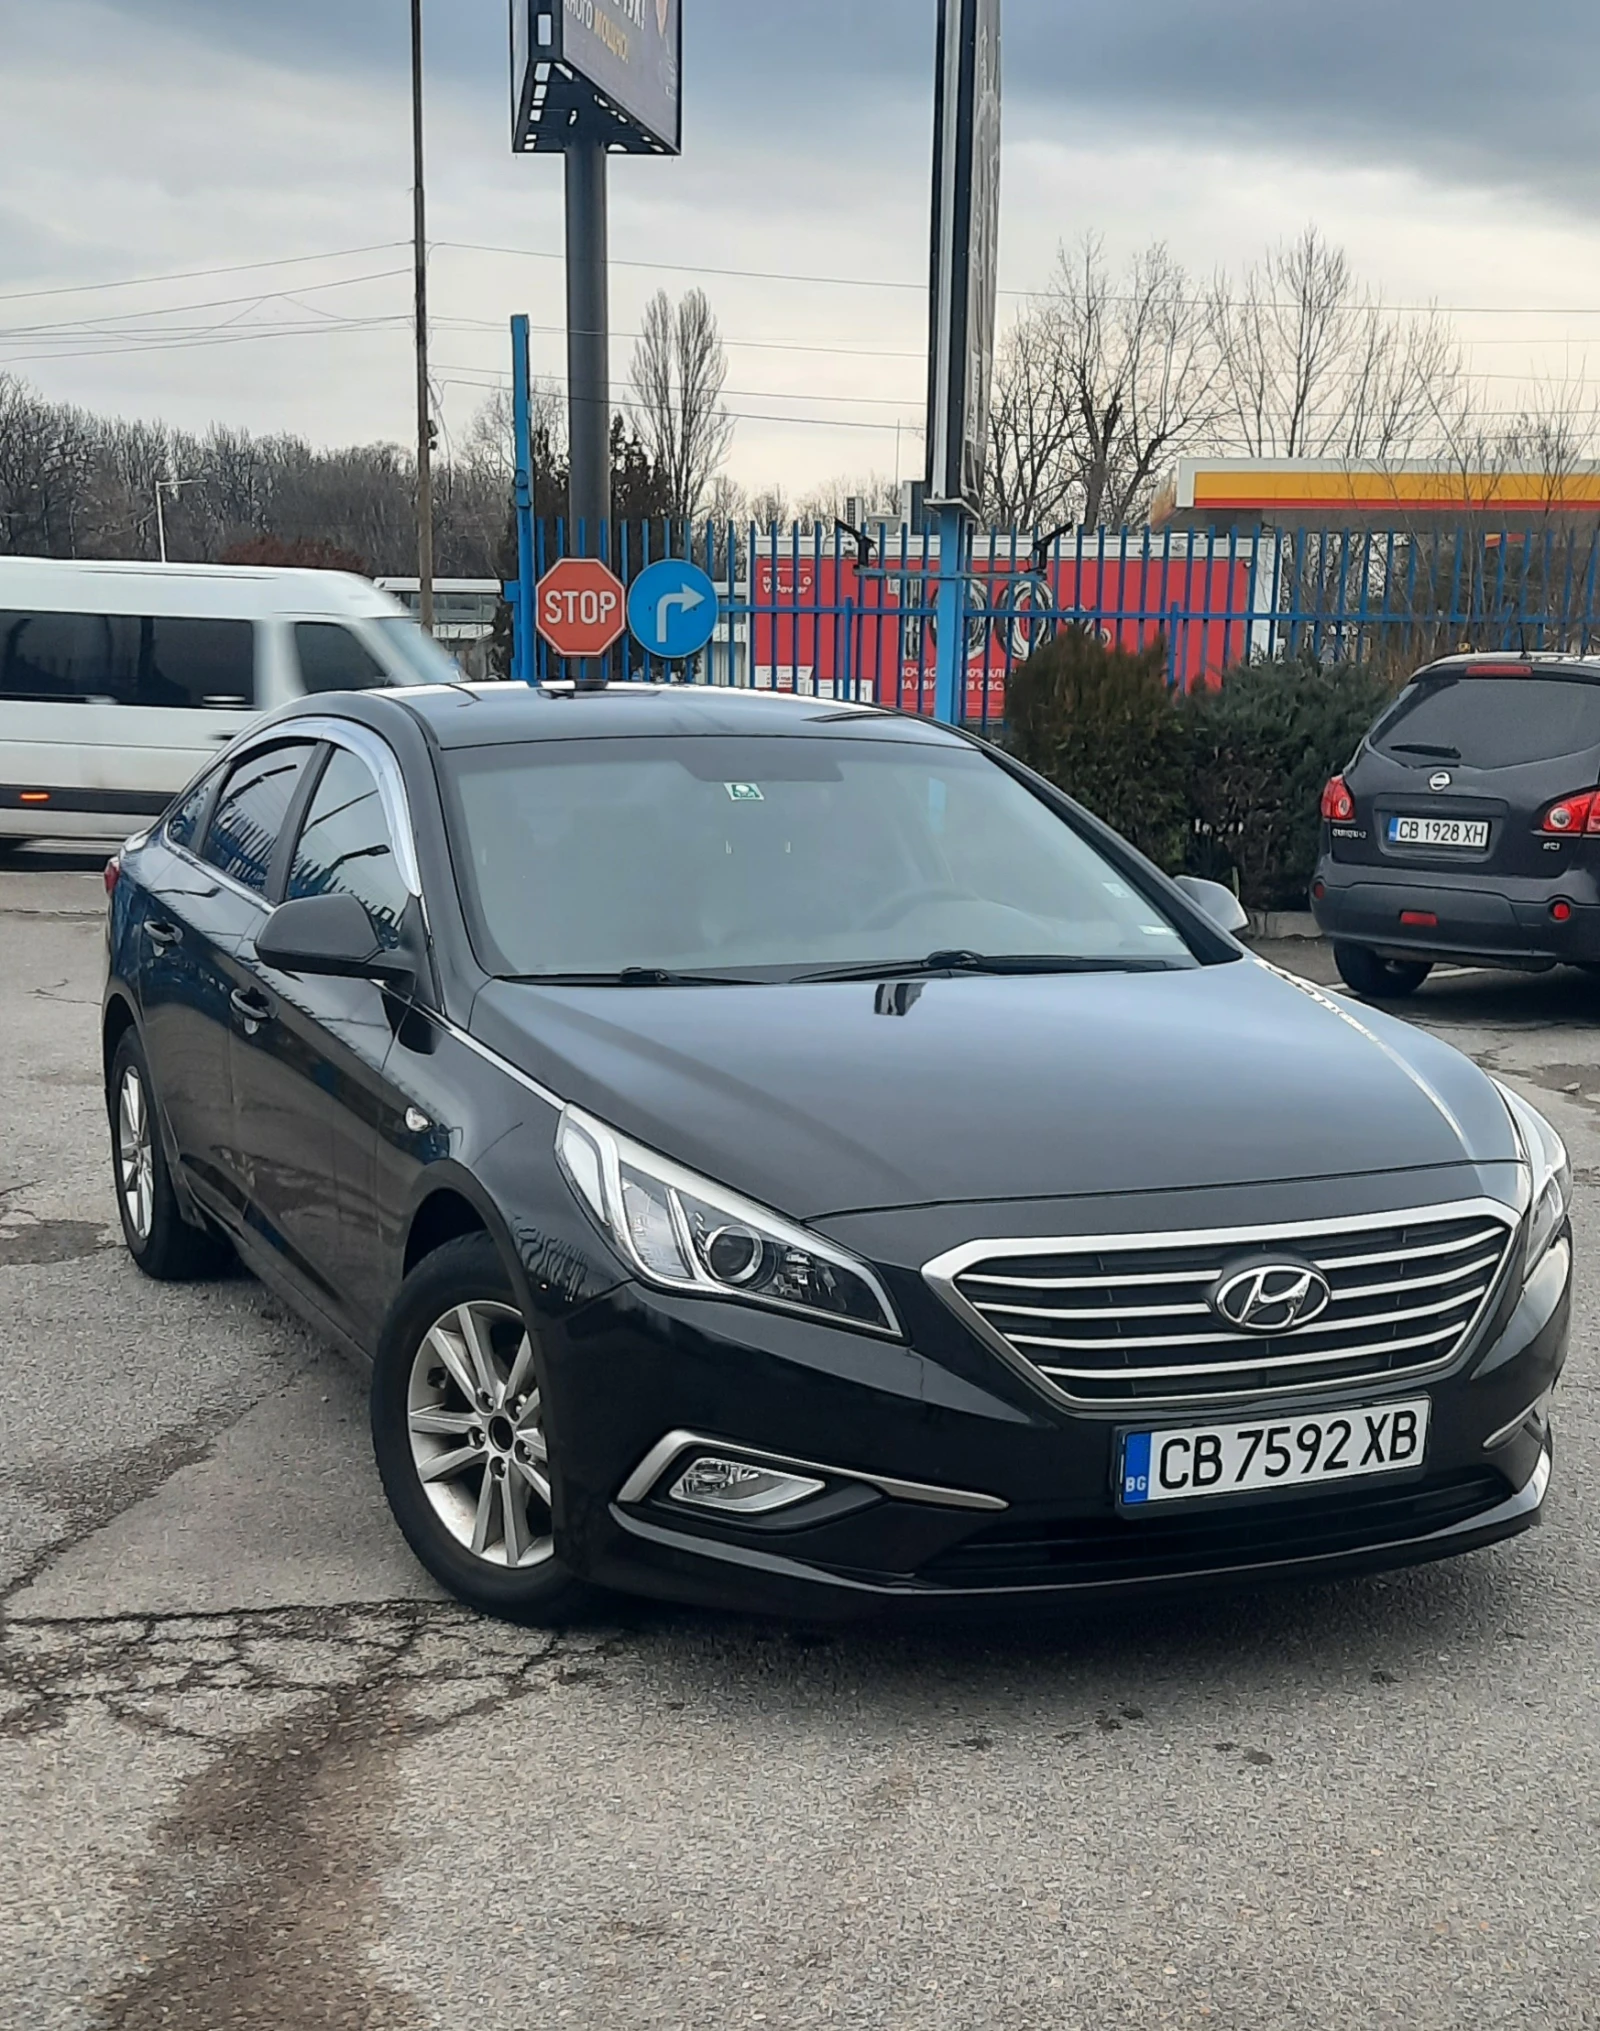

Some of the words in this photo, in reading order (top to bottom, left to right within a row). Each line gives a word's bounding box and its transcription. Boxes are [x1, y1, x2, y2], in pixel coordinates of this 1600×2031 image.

[545, 590, 617, 624] STOP
[1398, 820, 1420, 840] CB
[1424, 822, 1460, 842] 1928
[1462, 825, 1485, 844] XH
[1159, 1434, 1223, 1490] CB
[1234, 1419, 1351, 1483] 7592
[1359, 1409, 1417, 1467] XB
[1125, 1475, 1146, 1492] BG
